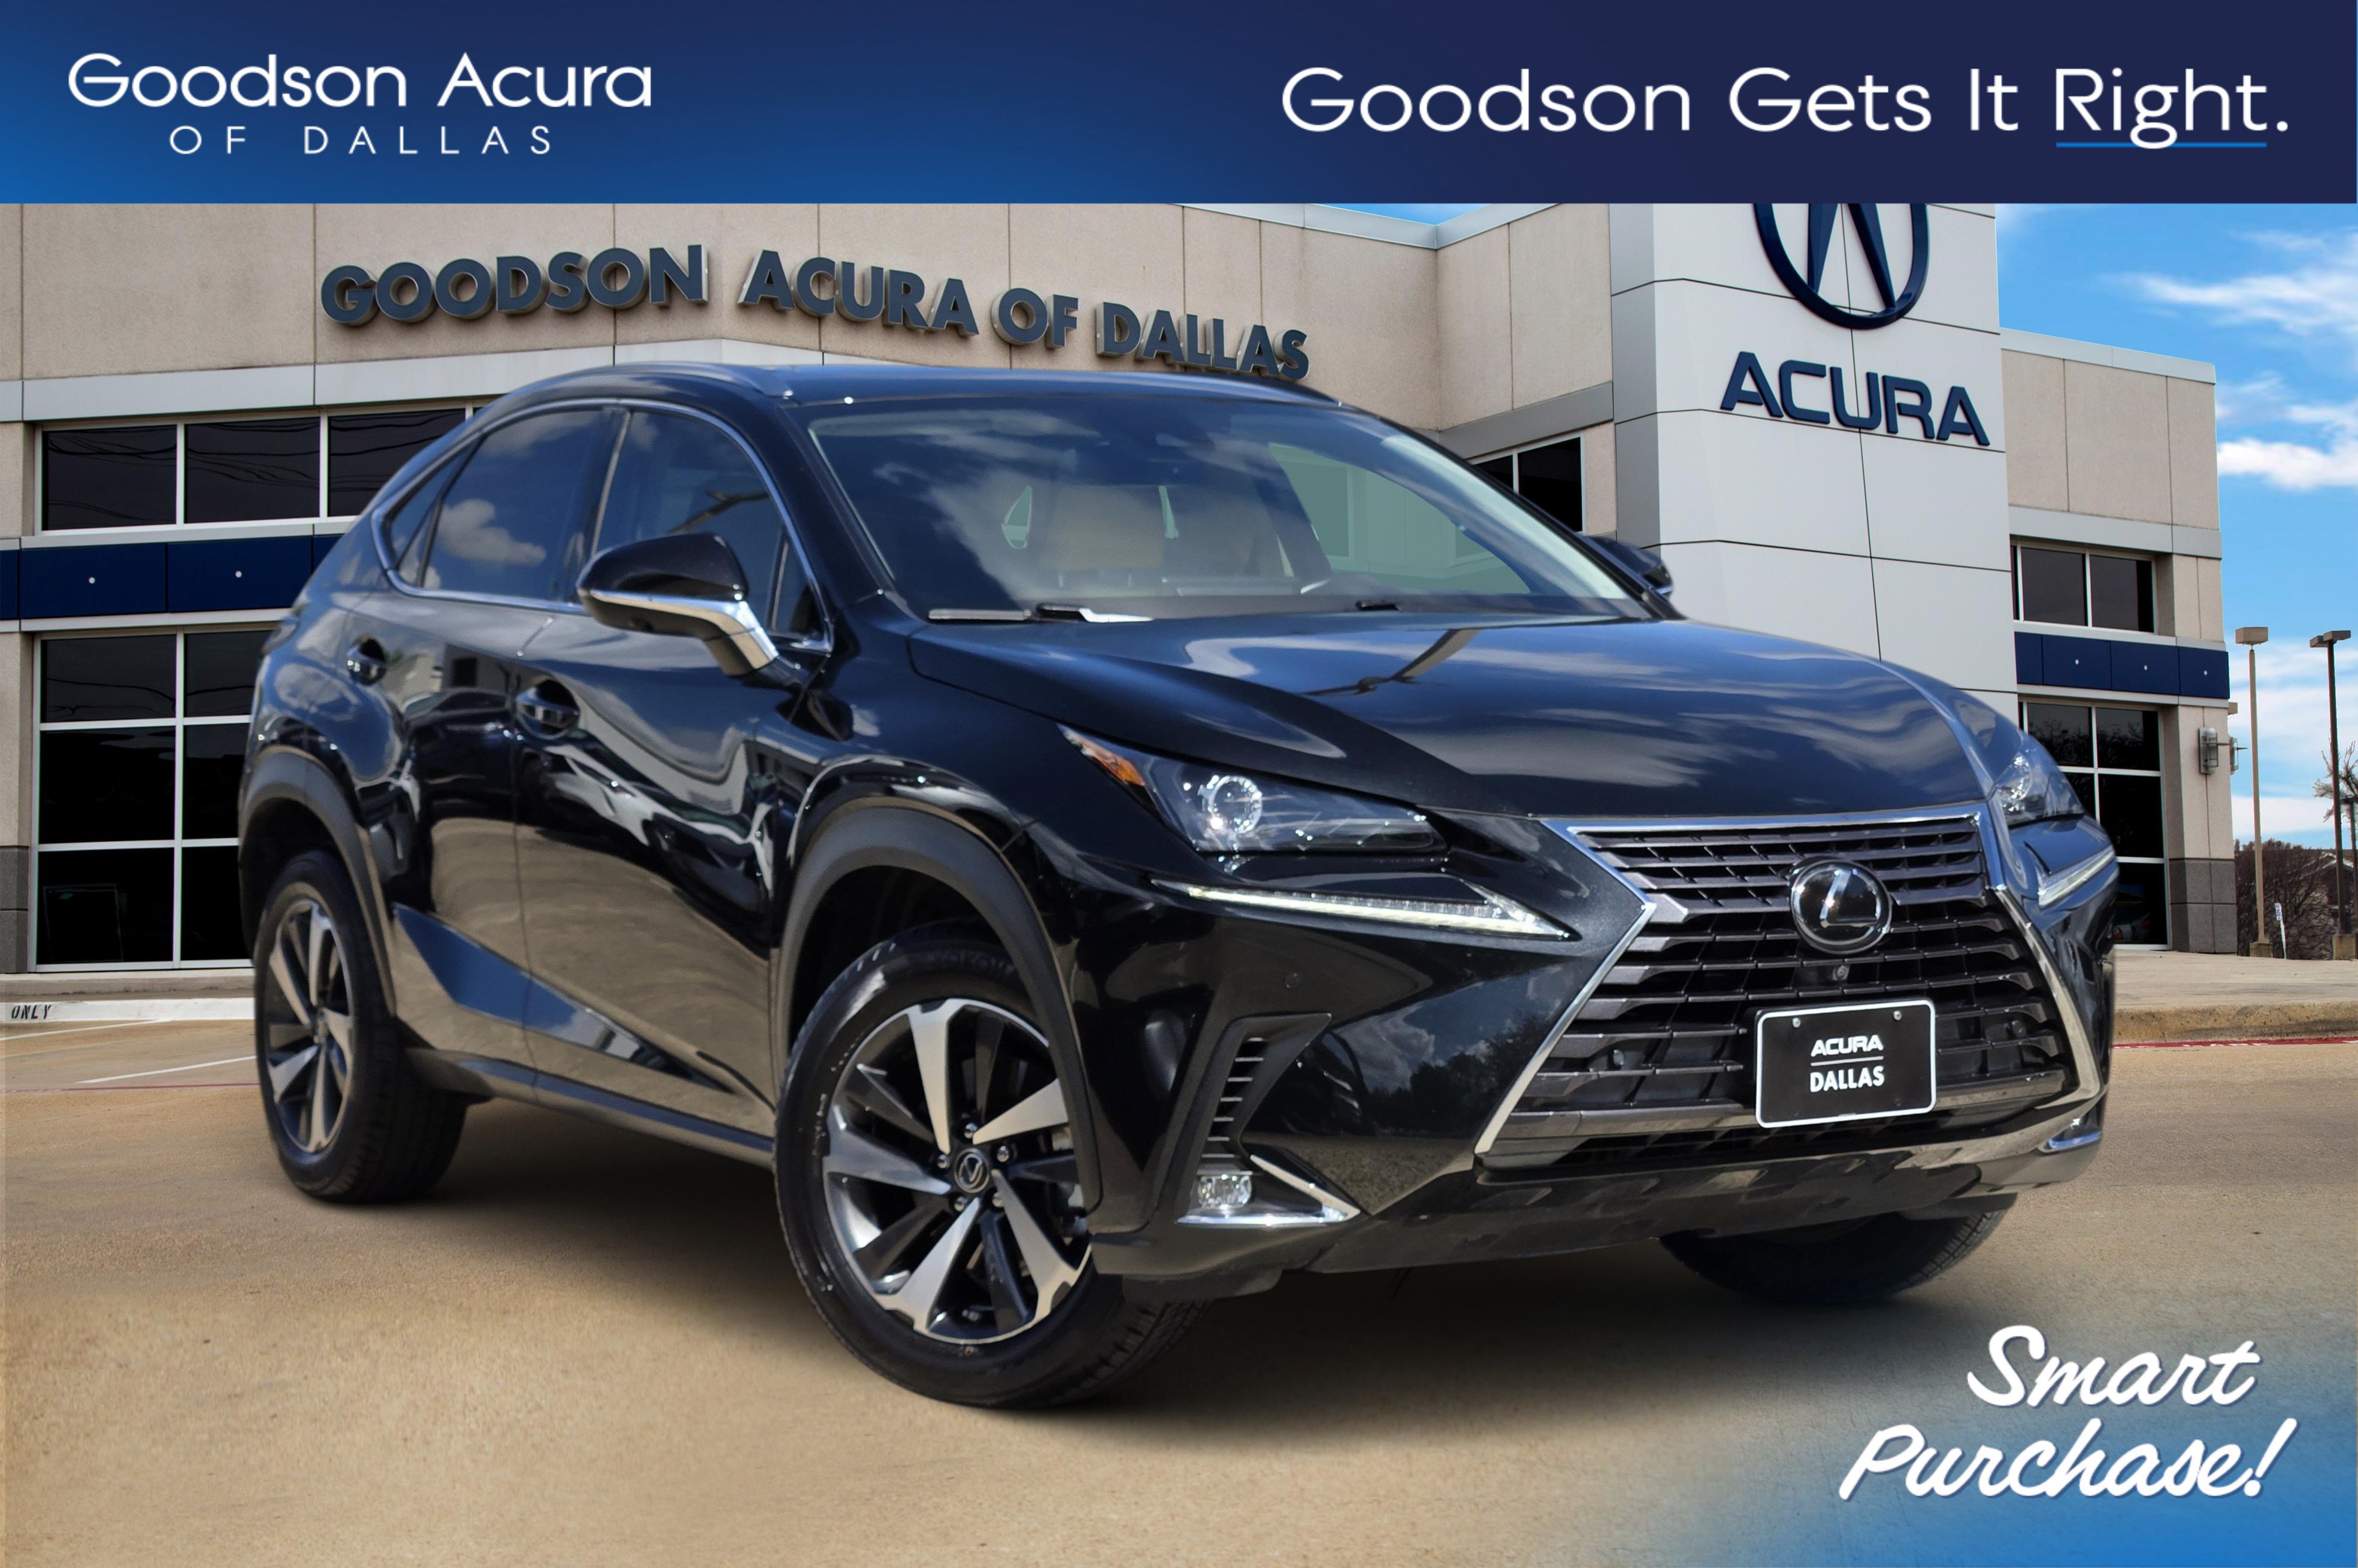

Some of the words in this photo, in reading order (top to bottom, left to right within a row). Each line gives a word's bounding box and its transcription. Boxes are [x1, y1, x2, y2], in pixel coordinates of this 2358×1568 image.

[320, 244, 709, 327] GOODSON
[737, 249, 980, 337] ACURA
[991, 287, 1078, 349] OF
[1095, 301, 1310, 382] DALLAS
[1720, 351, 1990, 446] ACURA
[11, 1004, 52, 1019] ONLY
[1811, 1034, 1884, 1057] ACURA
[1810, 1065, 1885, 1092] DALLAS
